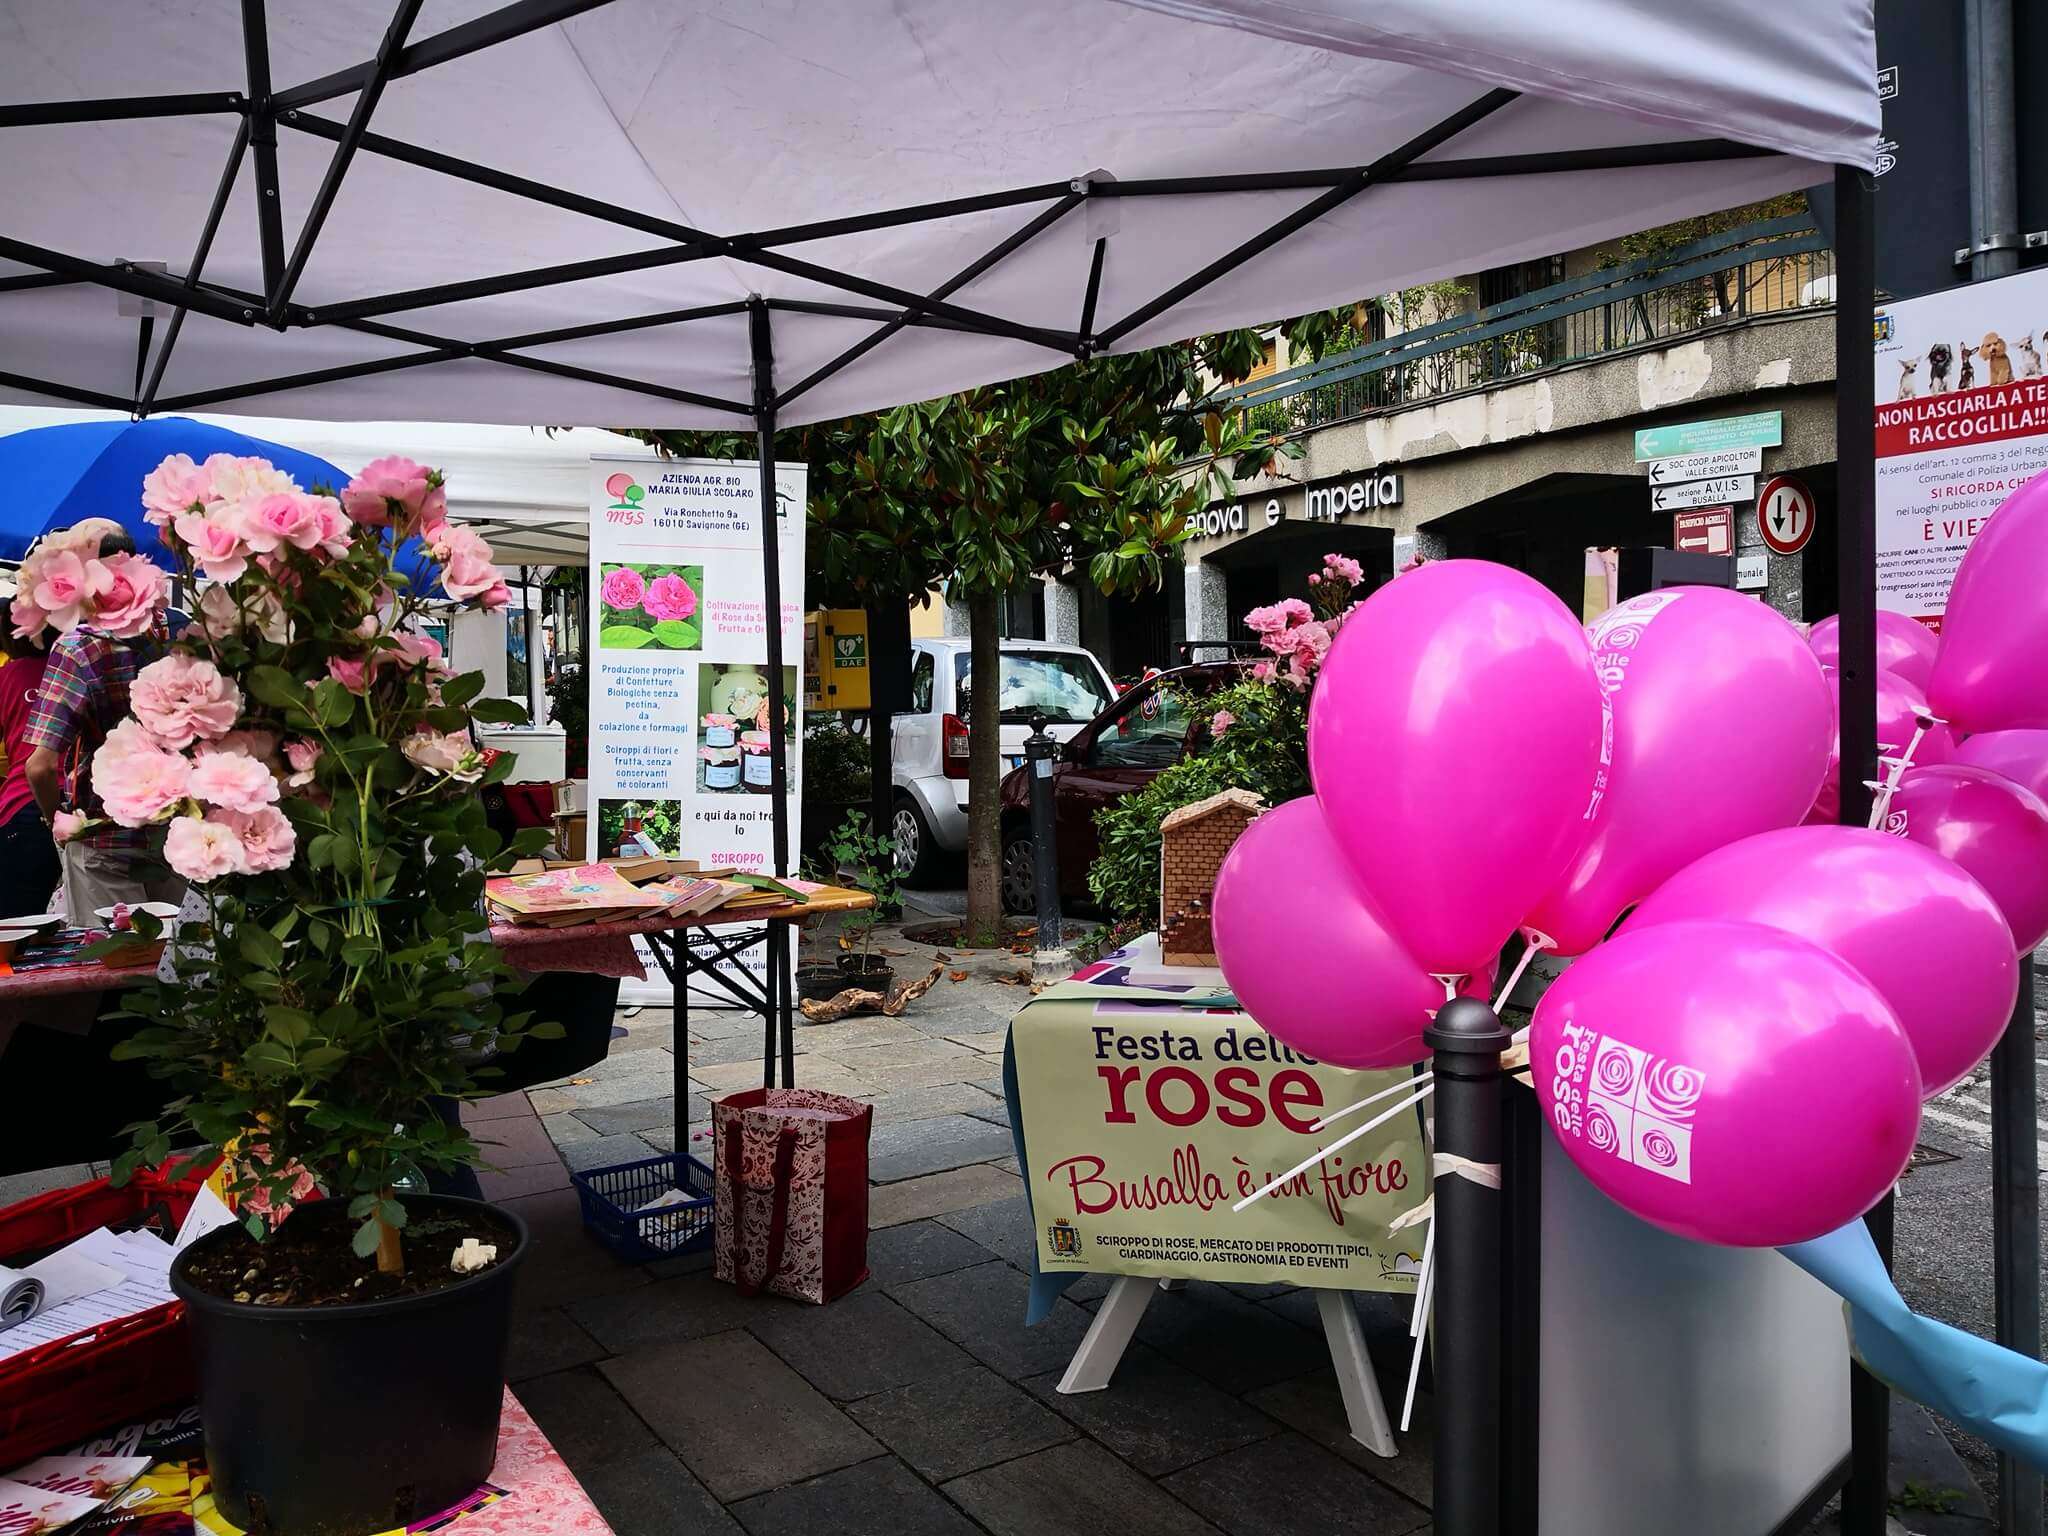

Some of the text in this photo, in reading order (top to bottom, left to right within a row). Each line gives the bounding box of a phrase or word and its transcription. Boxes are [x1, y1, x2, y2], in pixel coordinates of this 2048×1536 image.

[1917, 392, 2007, 421] LASCIARLA
[2010, 389, 2023, 405] A
[1712, 450, 1757, 464] APICOLTORI
[1889, 464, 1912, 475] sensi
[1951, 458, 1959, 466] 12
[1962, 452, 1997, 464] comma
[2007, 448, 2022, 458] del
[1685, 464, 1739, 477] VALLE SCRIVIA
[1918, 460, 2047, 484] Comunale di Polizia Urbana
[662, 474, 701, 485] AZIENDA
[726, 477, 741, 486] BIO
[648, 485, 754, 498] MARIA GIULIA SCOLARO
[1705, 479, 1741, 494] A.V.I.S.
[1931, 488, 1943, 498] SI
[1946, 482, 2005, 497] RICORDA
[1692, 495, 1727, 505] BUSALLA
[664, 507, 738, 519] Via Ronchetto 9a
[1896, 505, 1910, 516] nei
[1912, 502, 1940, 517] luoghi
[1942, 498, 1979, 513] pubblici
[653, 519, 750, 531] 16010 Savignone (GE)
[1923, 518, 1935, 541] È
[706, 601, 760, 611] Coltivazione
[711, 612, 720, 621] di
[722, 613, 742, 621] Rose
[744, 613, 754, 622] da
[718, 623, 746, 633] Frutta
[841, 659, 863, 667] DAE
[601, 664, 685, 676] Produzione propria
[615, 676, 673, 686] di Confetture
[607, 687, 679, 698] Biologiche senza
[638, 711, 649, 720] da
[599, 722, 641, 732] colazione
[649, 723, 688, 733] formaggi
[605, 744, 640, 756] Sciroppi
[642, 746, 651, 755] di
[653, 746, 672, 755] fiori
[616, 769, 667, 777] conservanti
[628, 780, 669, 789] coloranti
[695, 812, 701, 820] e
[703, 810, 721, 822] qui
[723, 809, 737, 821] da
[739, 810, 756, 821] noi
[735, 824, 745, 835] lo
[711, 853, 764, 864] SCIROPPO
[1092, 1026, 1203, 1062] Festa
[1553, 1020, 1586, 1130] rose
[1570, 1027, 1598, 1138] Festa delle
[1097, 1065, 1324, 1134] rose
[1048, 1143, 1229, 1215] Busalla
[1232, 1156, 1256, 1198] è
[1317, 1147, 1409, 1227] fiore
[1096, 1235, 1373, 1258] SCIROPPO DI ROSE, MERCATO DEI PRODOTTI TIPICI,
[1119, 1248, 1349, 1269] GIARDINAGGIO, GASTRONOMIA ED EVENTI
